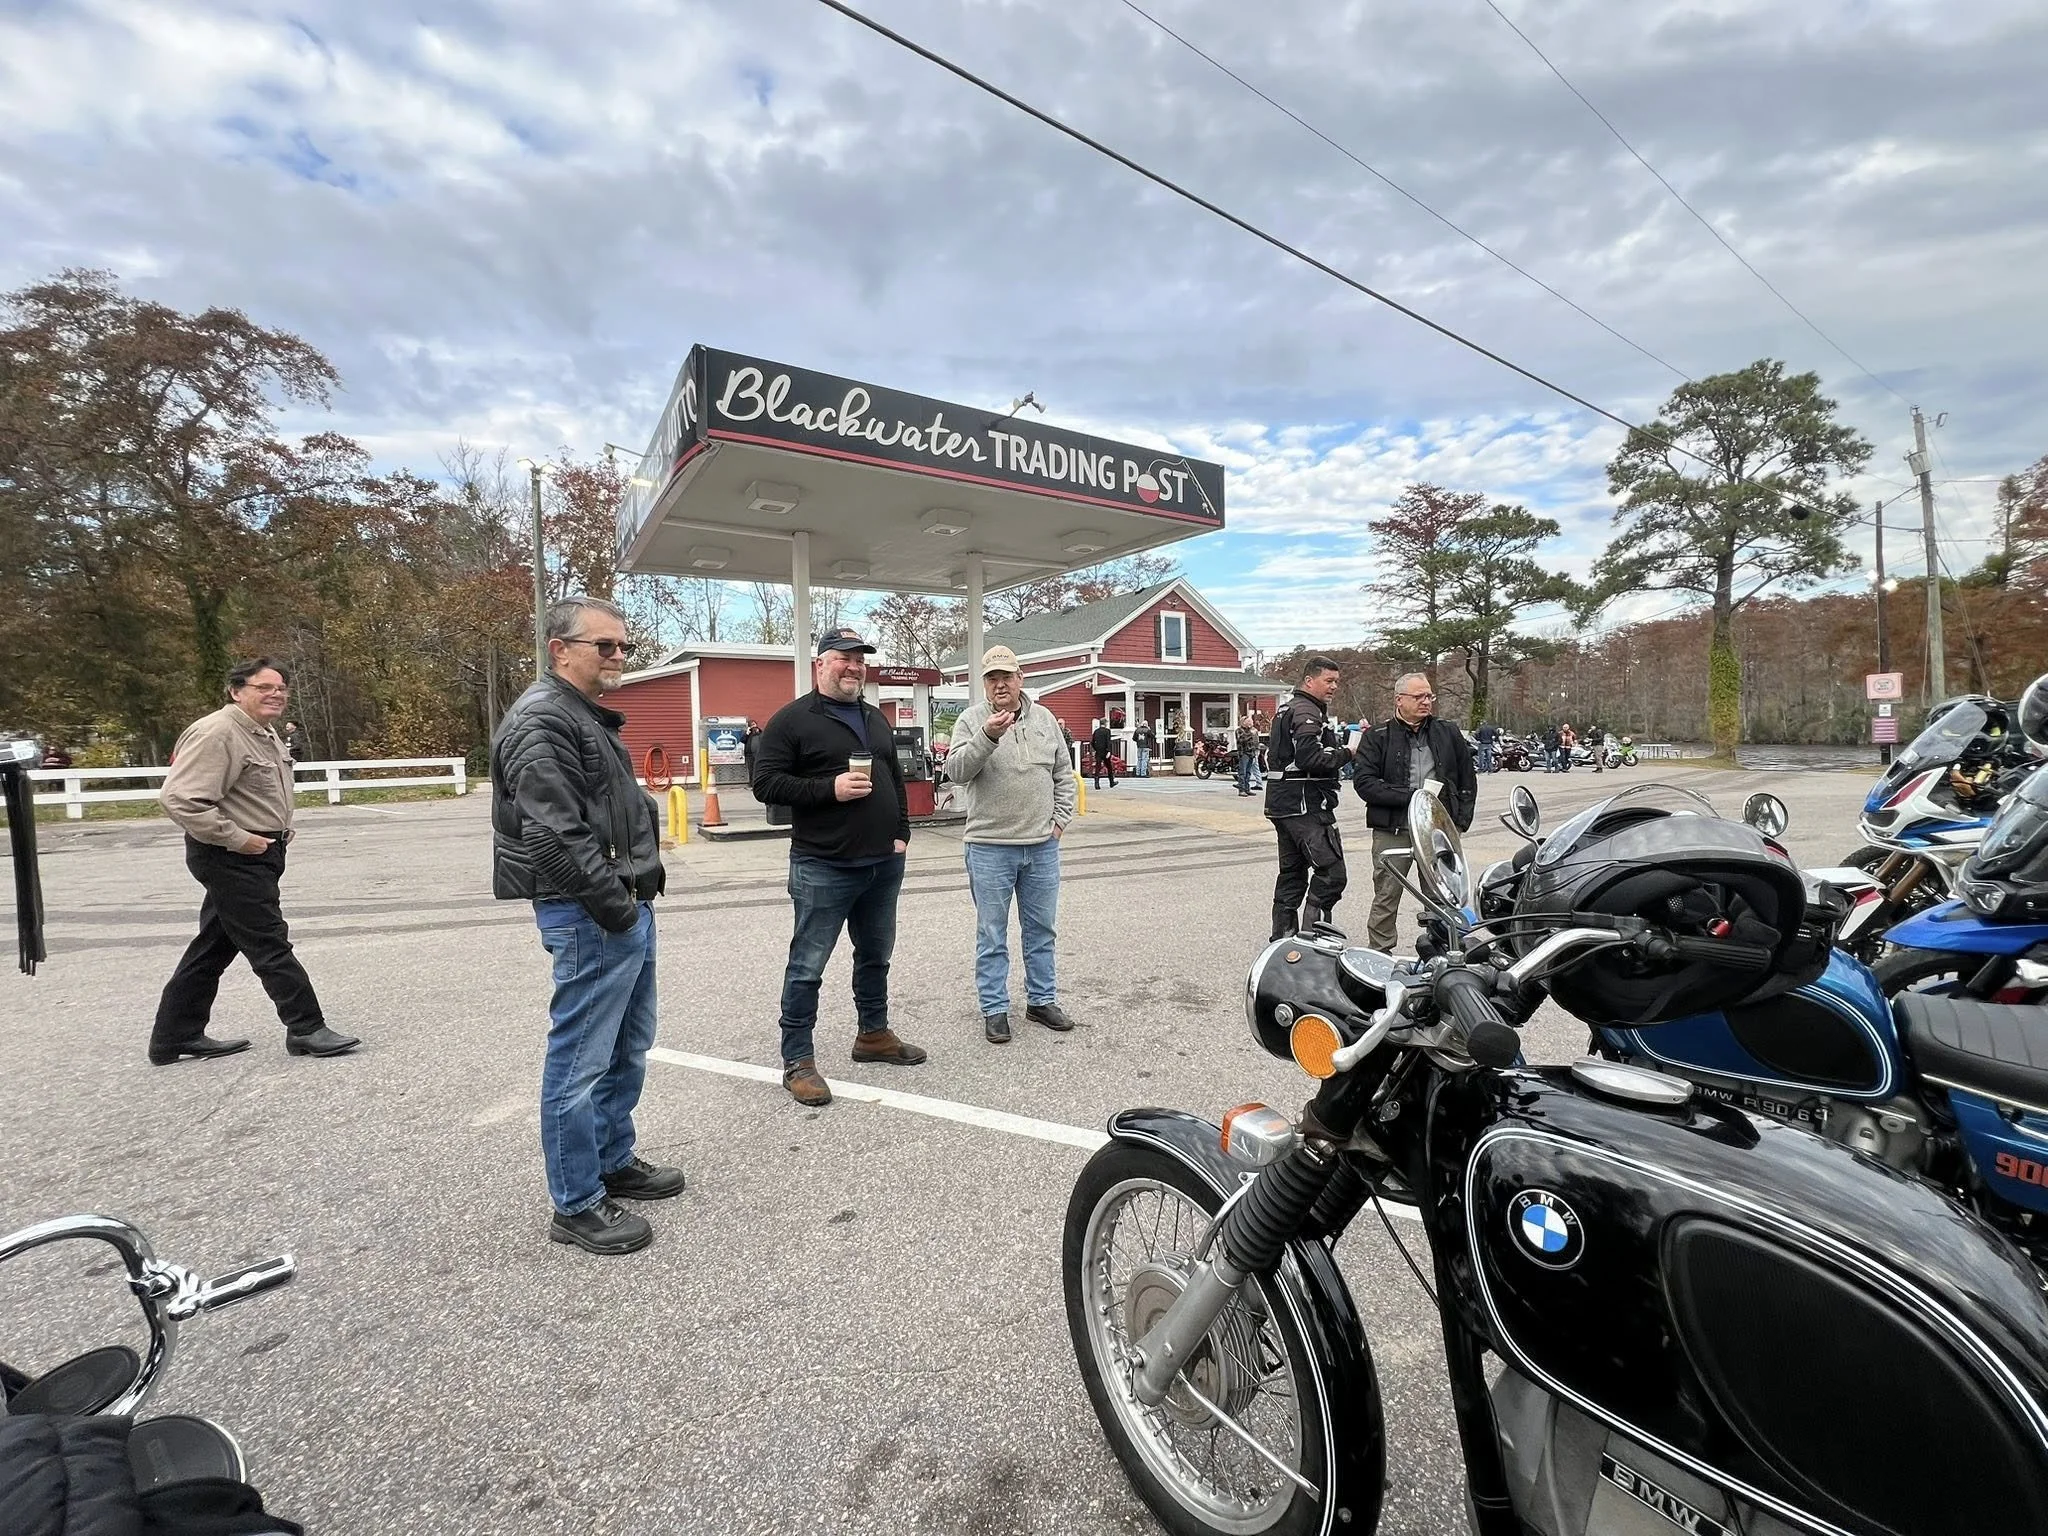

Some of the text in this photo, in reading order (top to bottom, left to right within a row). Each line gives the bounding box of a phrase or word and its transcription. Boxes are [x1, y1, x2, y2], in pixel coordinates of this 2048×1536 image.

[716, 366, 987, 462] Blackwater
[987, 430, 1115, 490] TRADING
[916, 736, 922, 746] 1
[1995, 1151, 2048, 1189] 90
[1518, 1193, 1577, 1226] BMW
[1613, 1463, 1700, 1532] BMW
